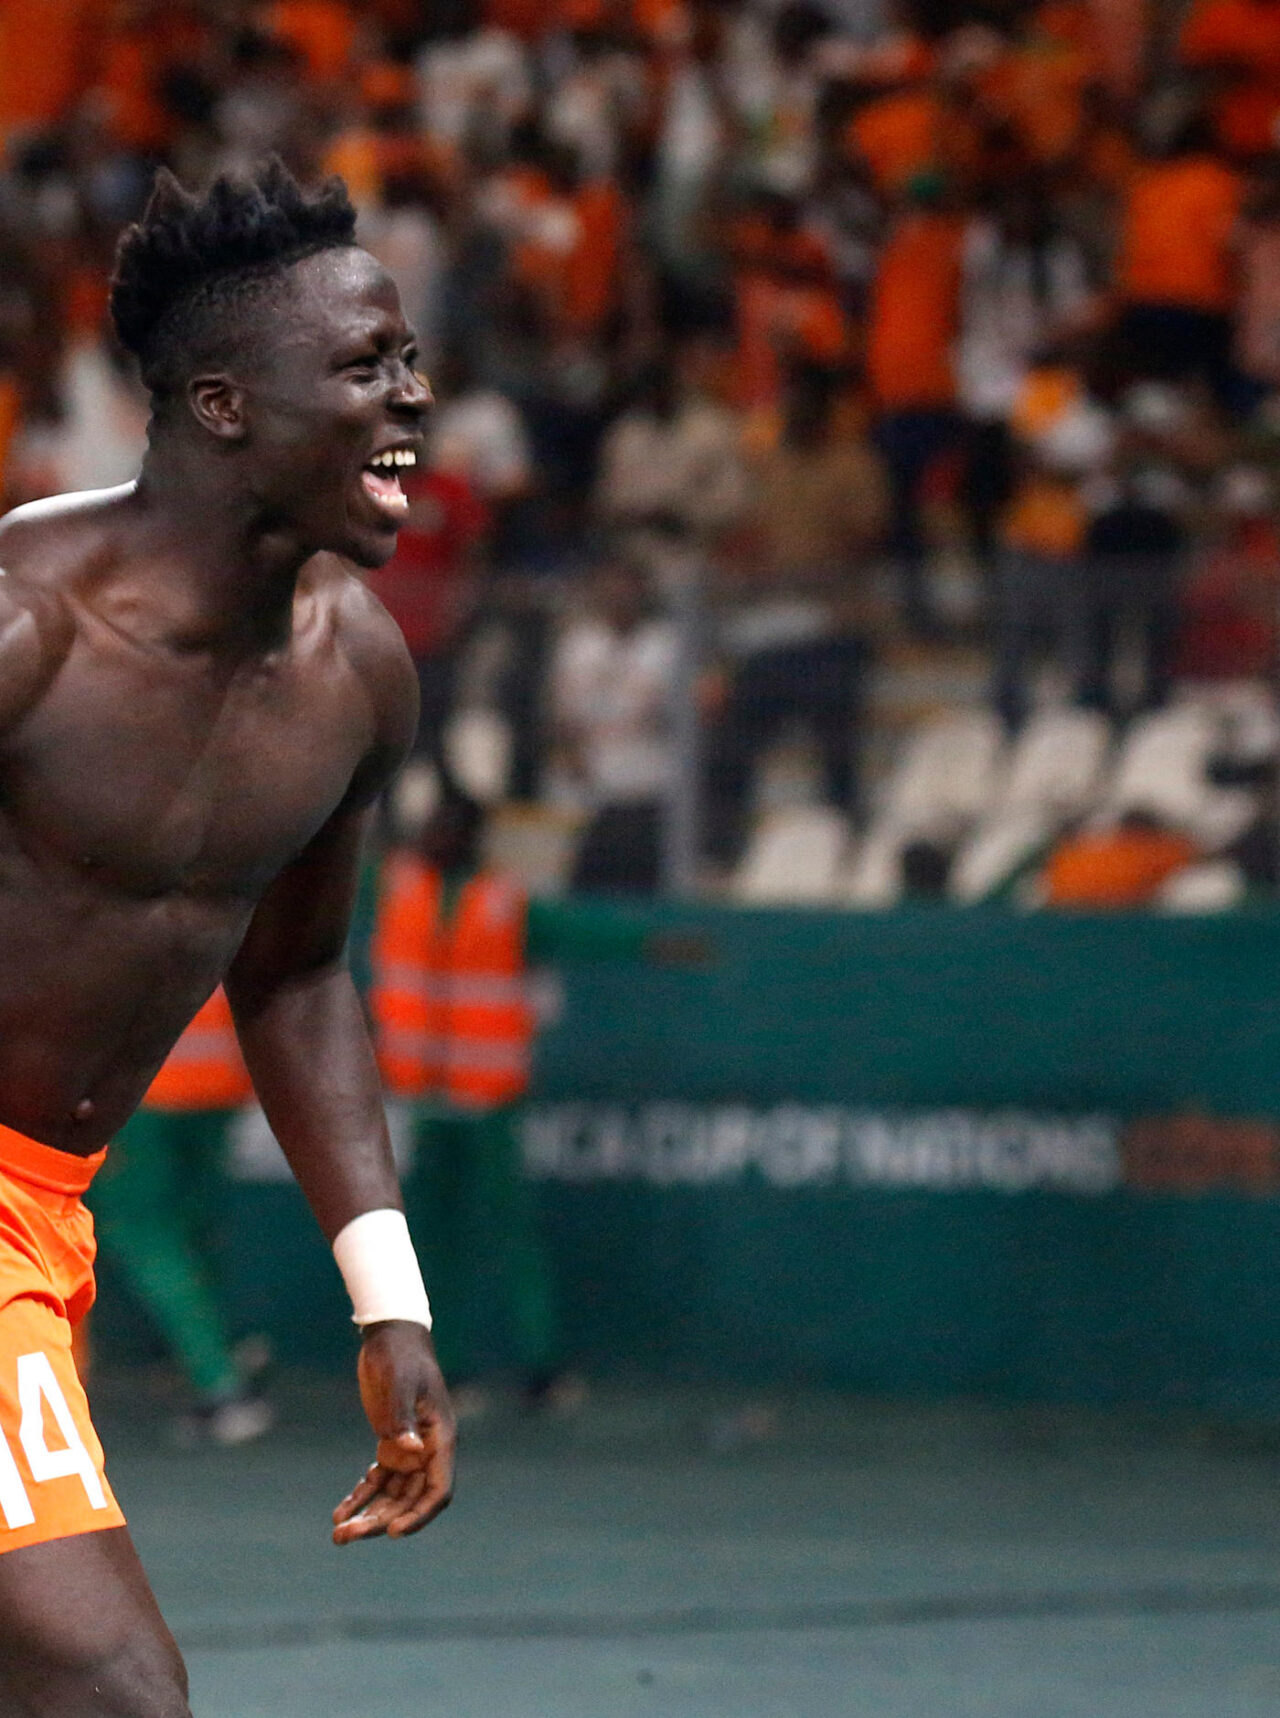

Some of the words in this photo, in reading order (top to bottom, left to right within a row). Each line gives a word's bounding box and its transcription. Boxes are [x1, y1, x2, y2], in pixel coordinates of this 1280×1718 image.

[642, 1104, 752, 1182] CUP
[758, 1106, 836, 1186] OF
[852, 1110, 1117, 1190] NATIONS
